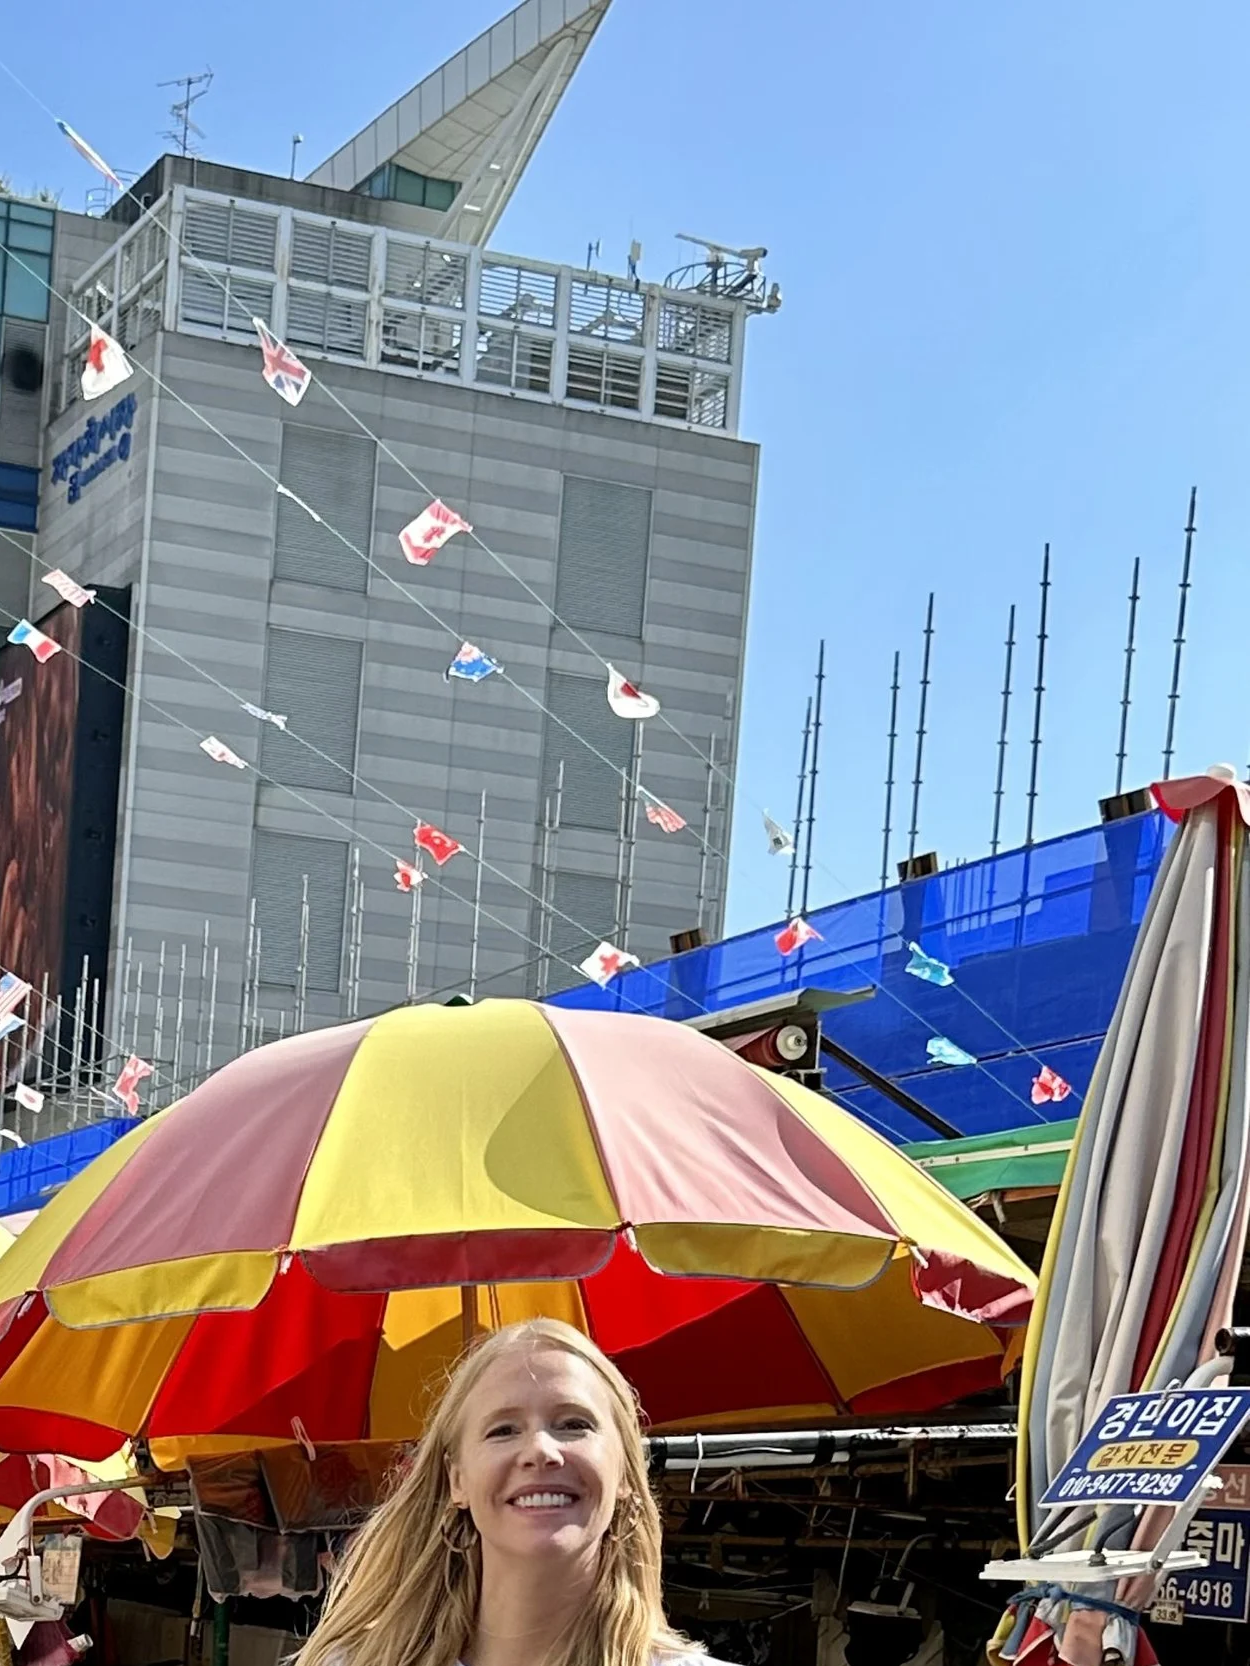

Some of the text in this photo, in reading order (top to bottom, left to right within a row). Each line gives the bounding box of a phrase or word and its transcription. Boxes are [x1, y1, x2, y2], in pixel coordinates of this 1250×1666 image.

[1097, 1396, 1242, 1440] 경민이집
[1096, 1443, 1188, 1468] 갈치전문
[1057, 1473, 1184, 1498] 010-9477-9299
